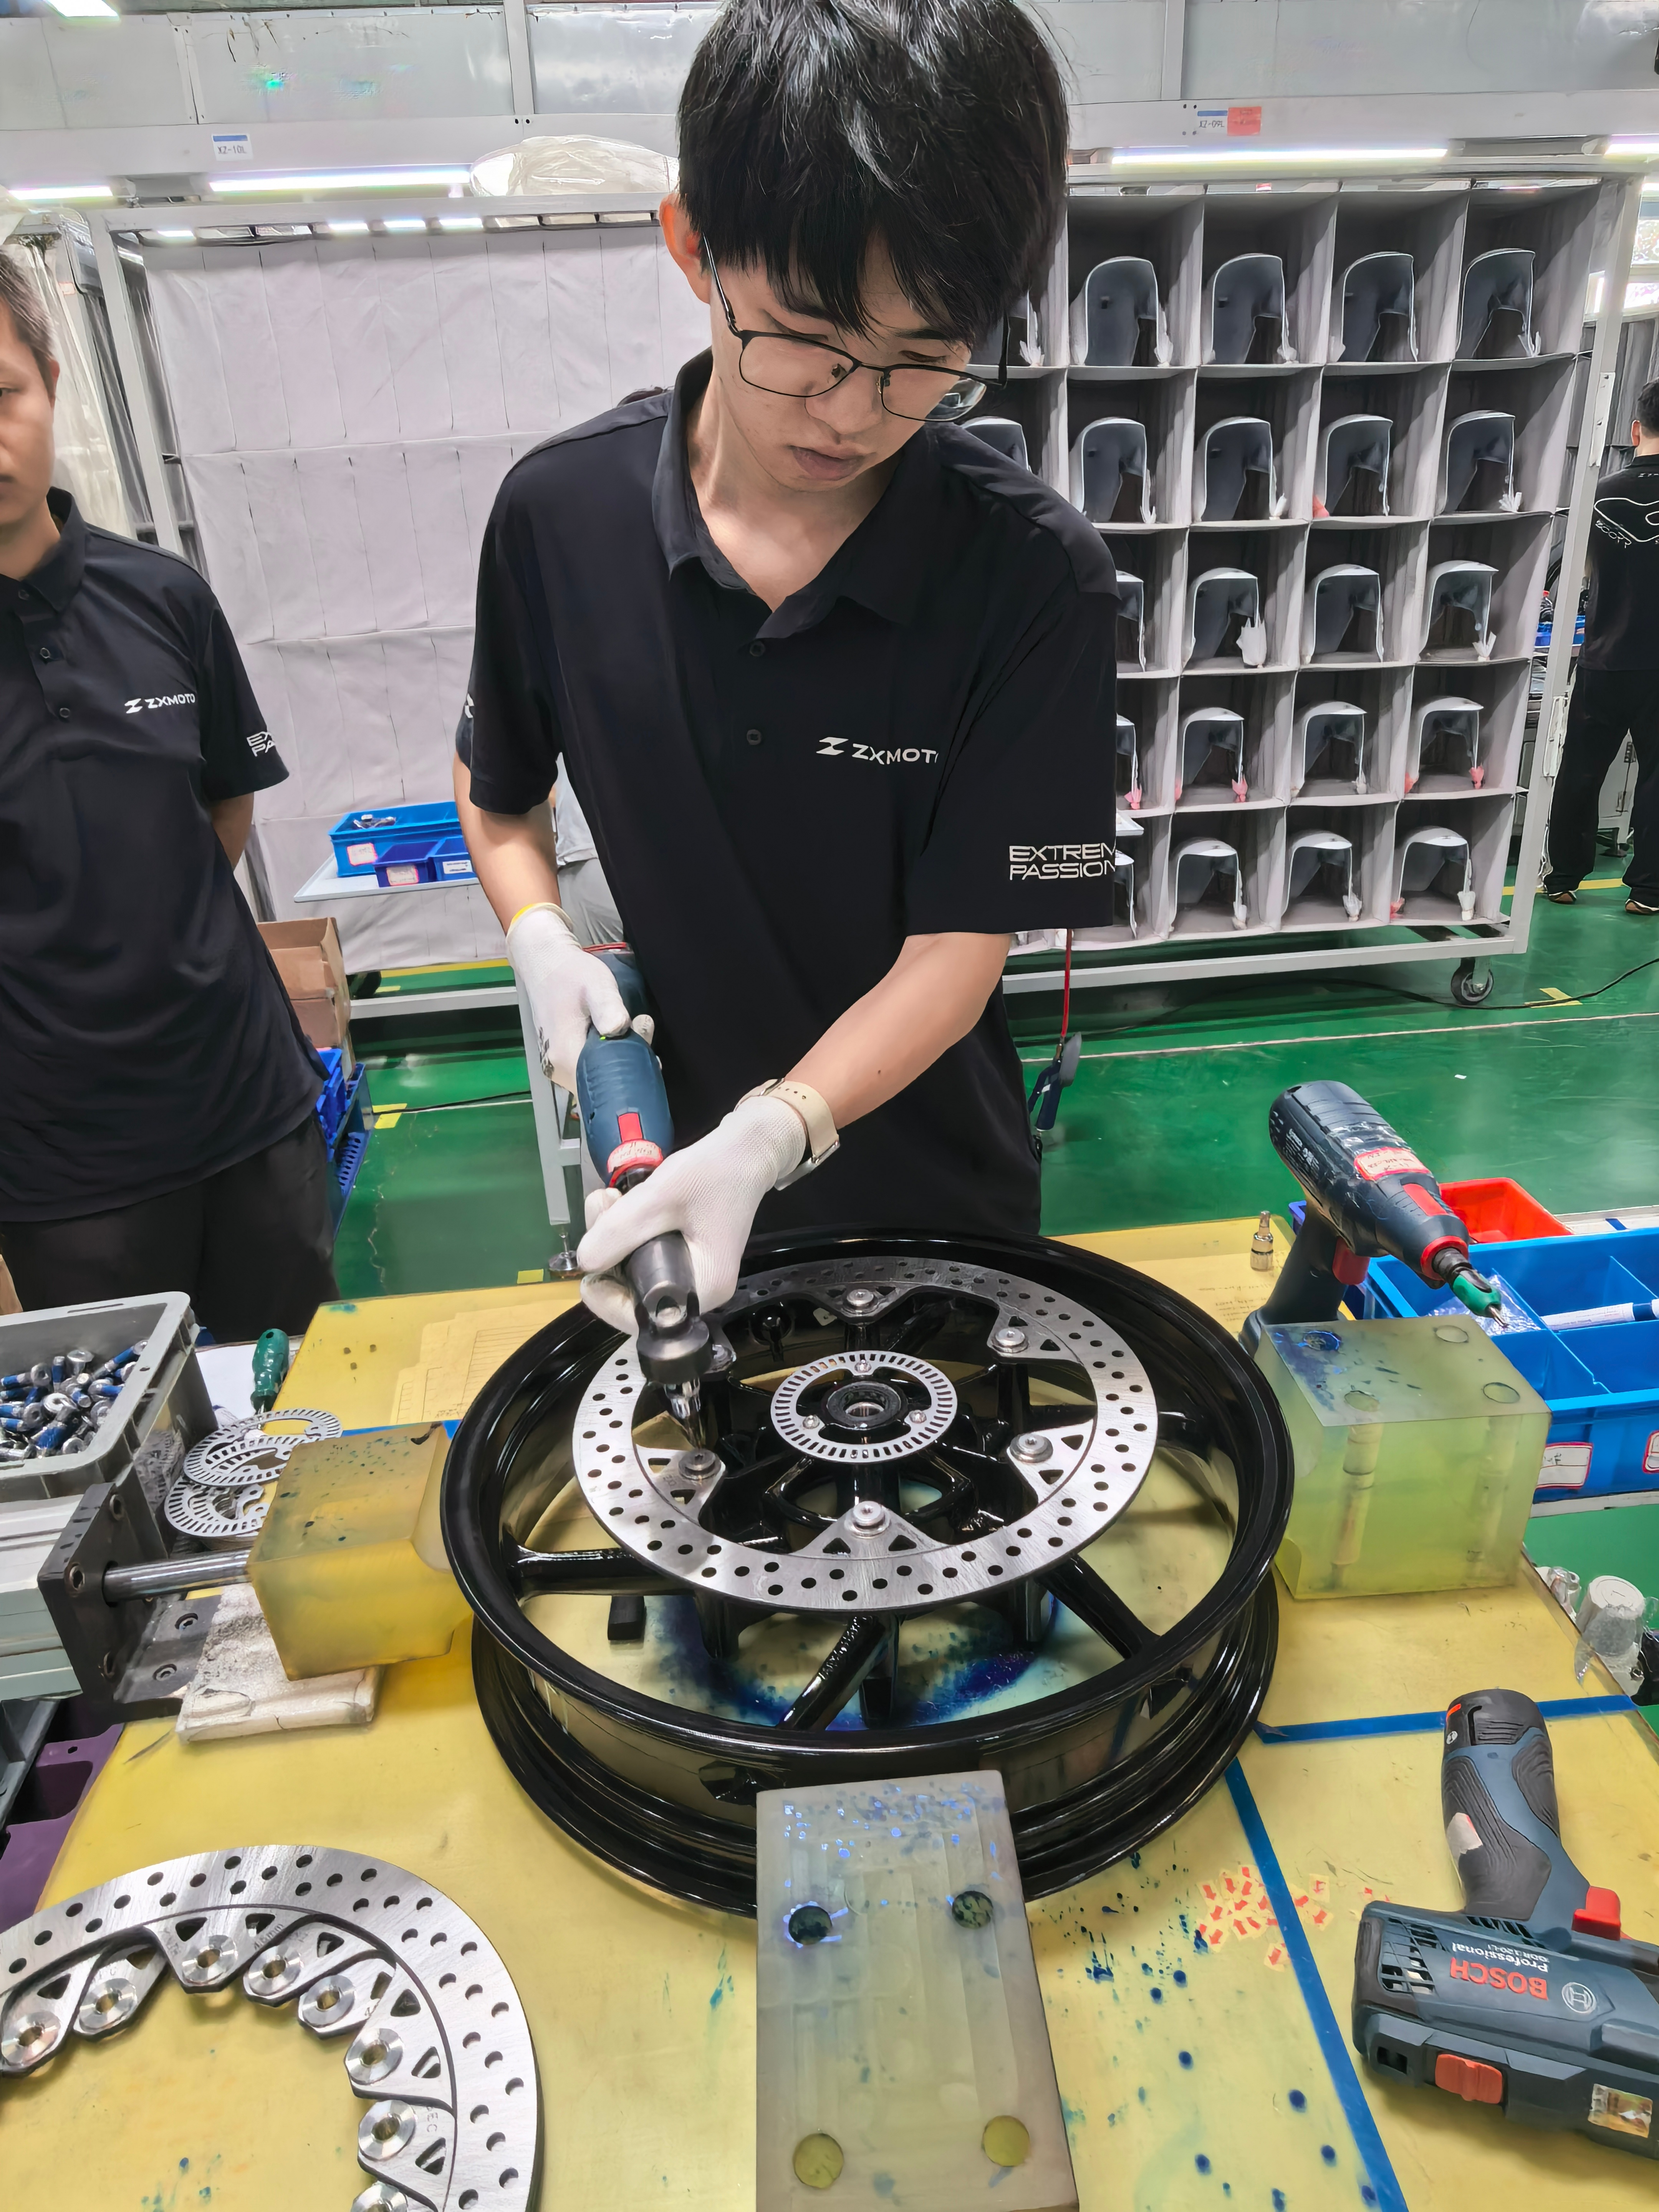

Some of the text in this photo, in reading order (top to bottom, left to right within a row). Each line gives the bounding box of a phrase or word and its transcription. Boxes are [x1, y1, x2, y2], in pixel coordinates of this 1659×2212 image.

[144, 693, 195, 709] ZXMOTO
[852, 743, 939, 765] ZXMOT
[1452, 1942, 1548, 1973] Professional
[1450, 1957, 1548, 2000] BOSCH
